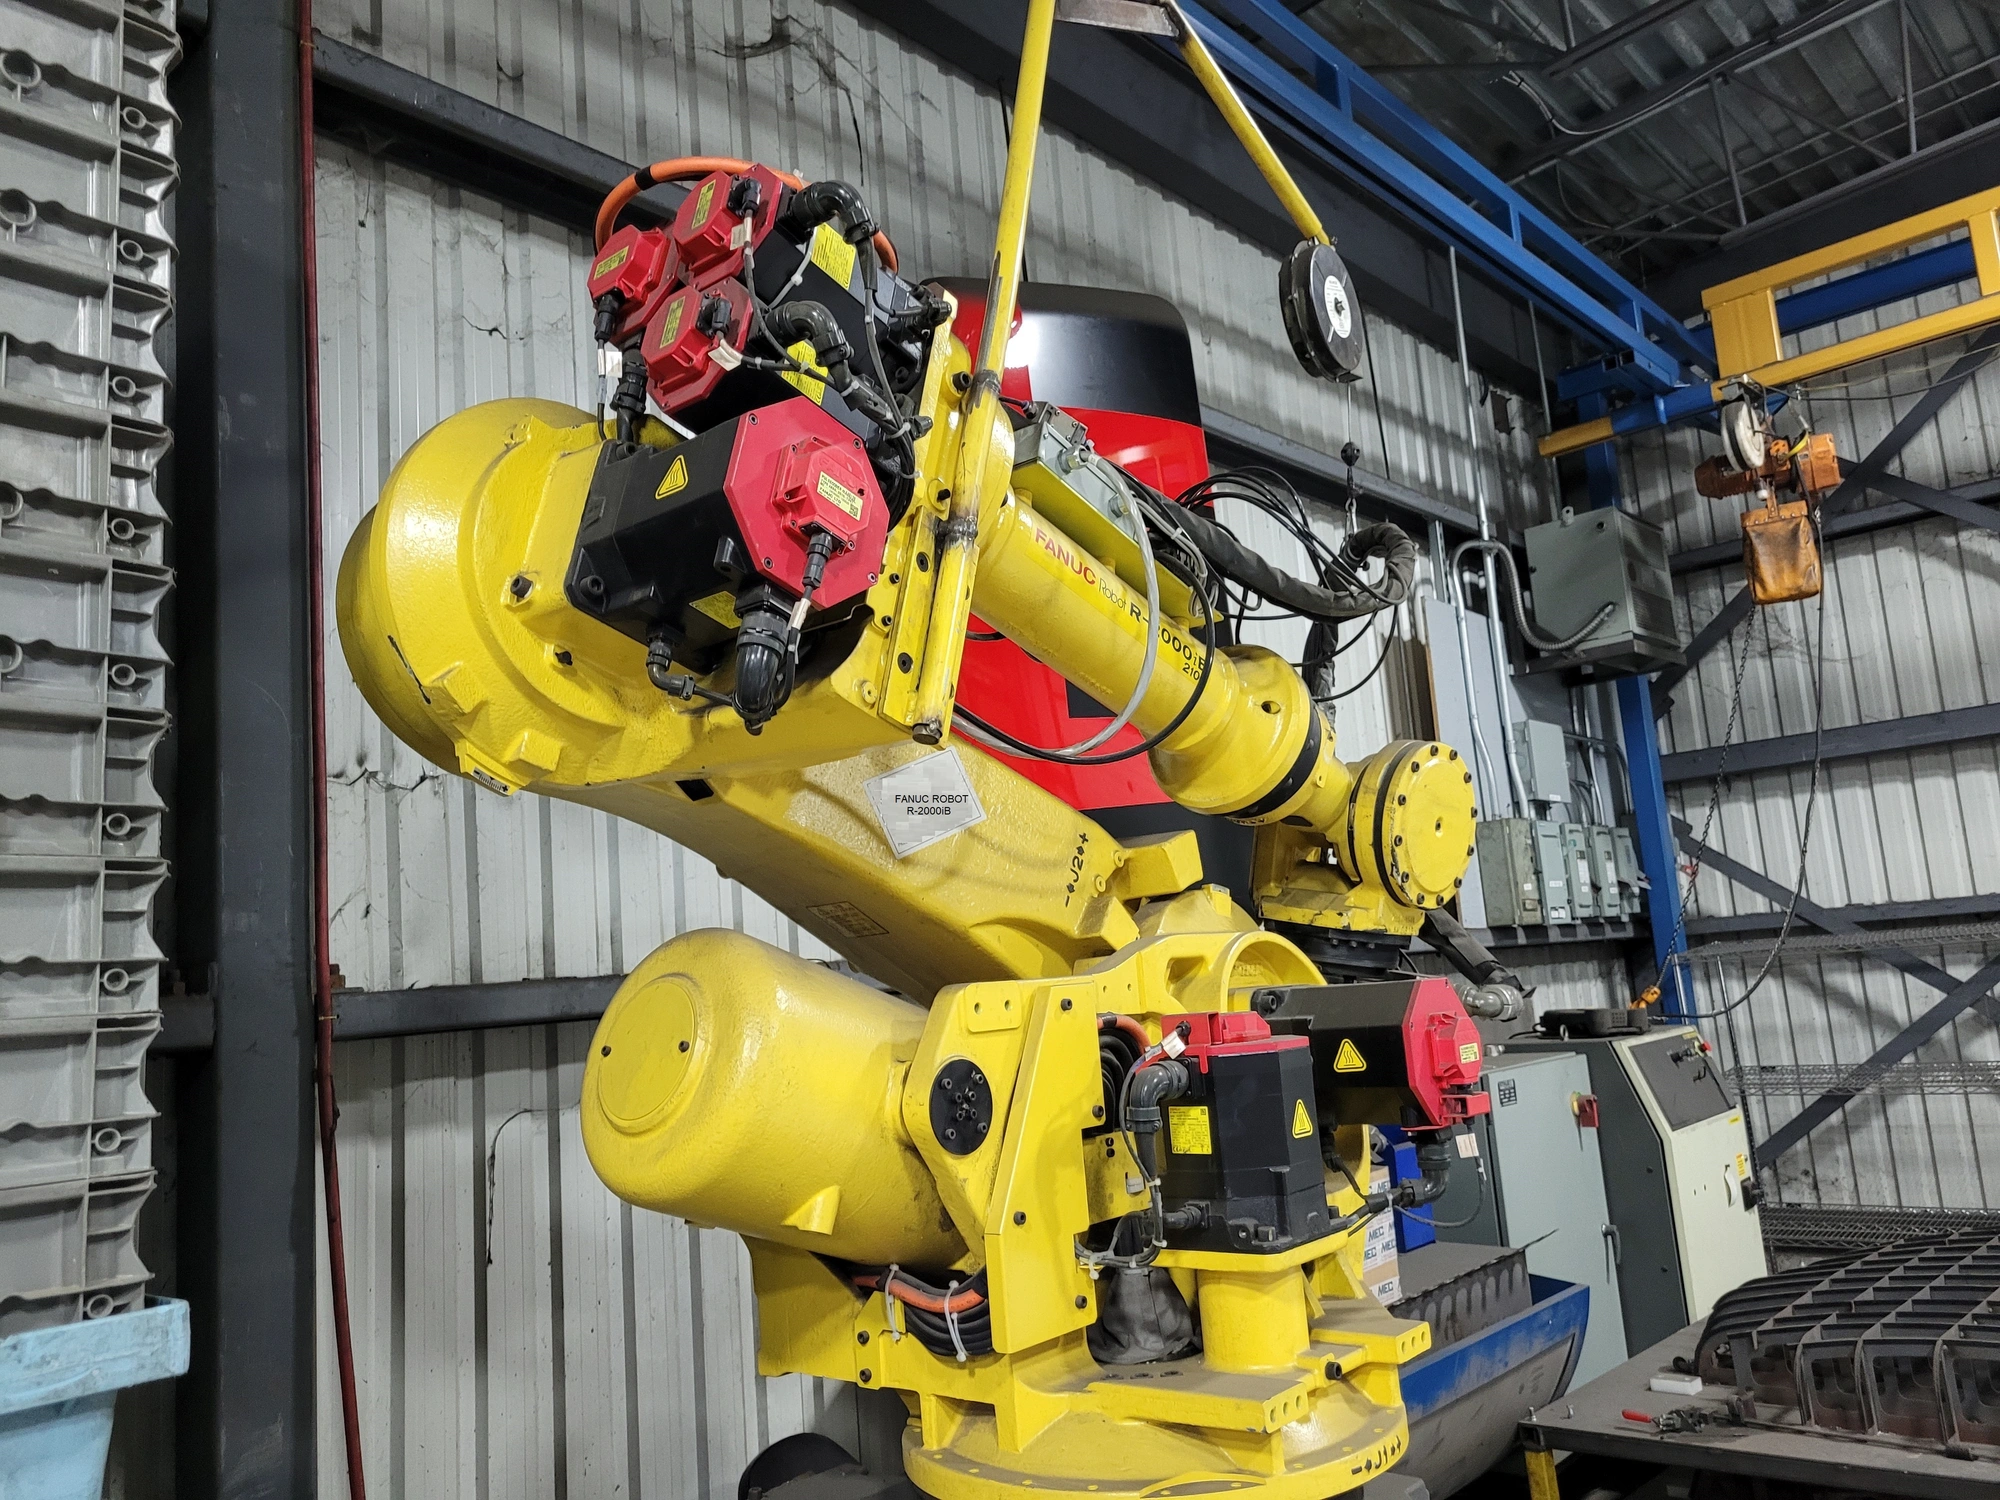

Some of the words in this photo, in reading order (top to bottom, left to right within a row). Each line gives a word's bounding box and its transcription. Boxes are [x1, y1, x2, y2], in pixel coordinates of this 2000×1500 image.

[1035, 527, 1096, 585] FANUC
[1099, 577, 1127, 612] Robot
[1182, 662, 1201, 681] 210
[1368, 1226, 1385, 1242] MEC
[1378, 1281, 1393, 1297] MEC
